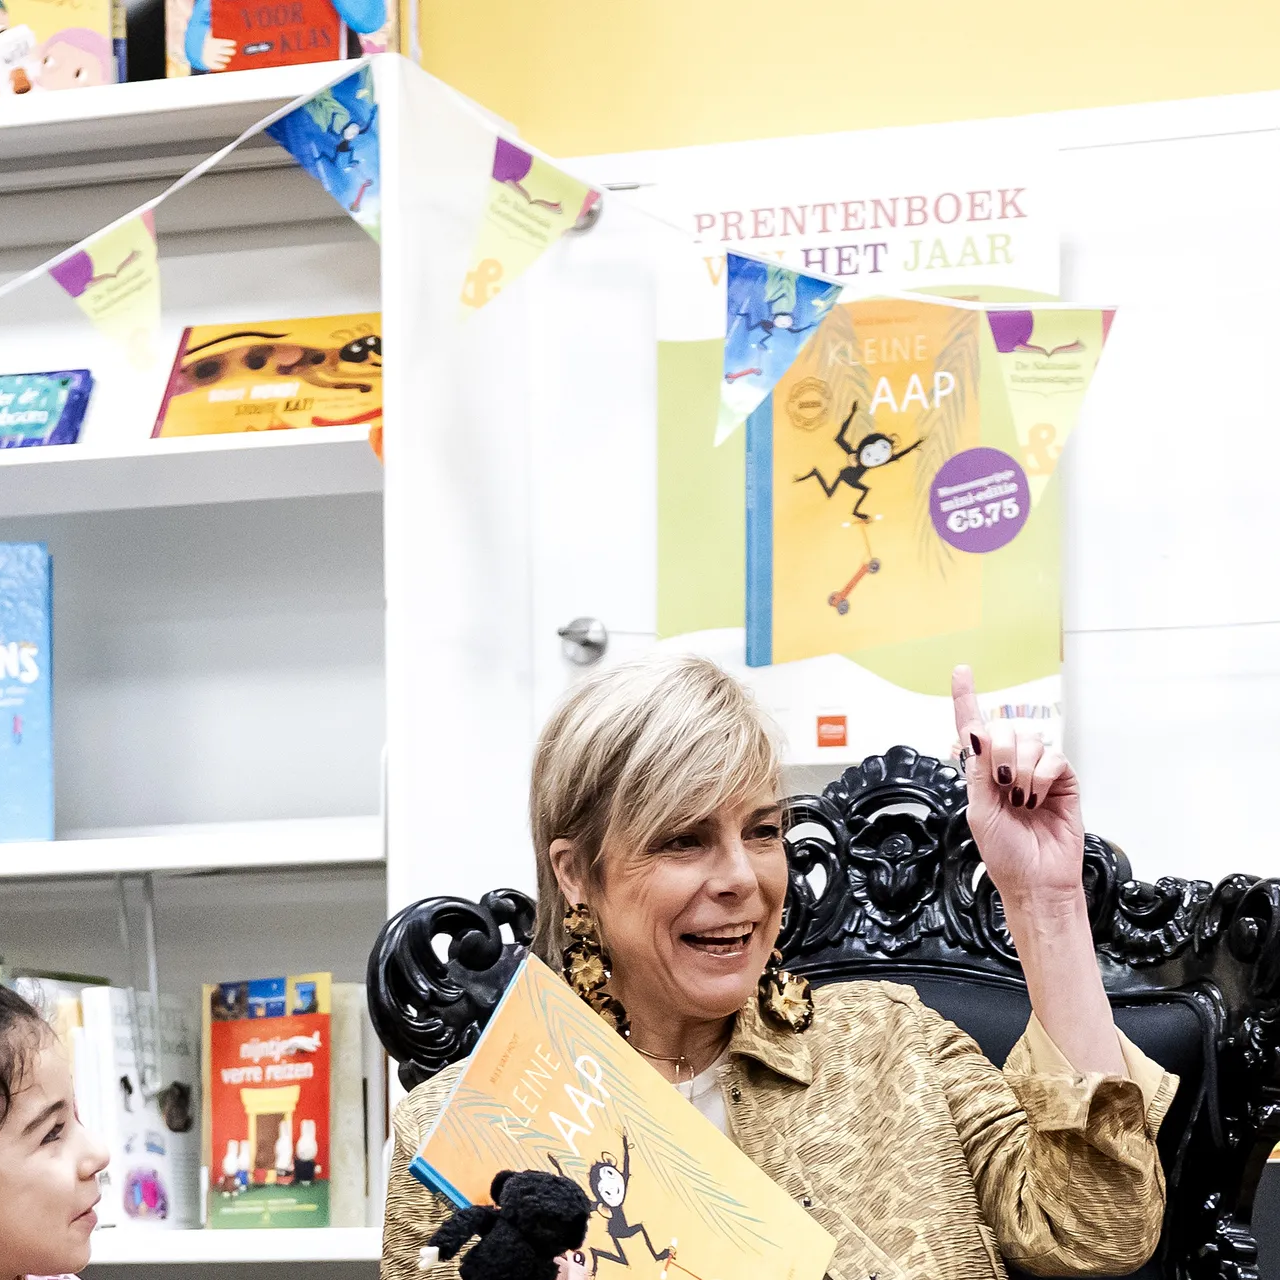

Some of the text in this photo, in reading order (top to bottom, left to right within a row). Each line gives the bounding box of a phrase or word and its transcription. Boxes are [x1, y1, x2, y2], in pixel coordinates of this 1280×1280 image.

[693, 187, 1028, 243] PRENTENBOEK
[801, 243, 888, 277] HET
[903, 233, 1015, 272] JAAR
[827, 335, 928, 367] KLEINE
[870, 371, 955, 416] AAP
[947, 497, 1020, 533] €5,75
[221, 1060, 314, 1085] verre reizen
[497, 1043, 561, 1144] KLEINE
[549, 1055, 611, 1157] AAP
